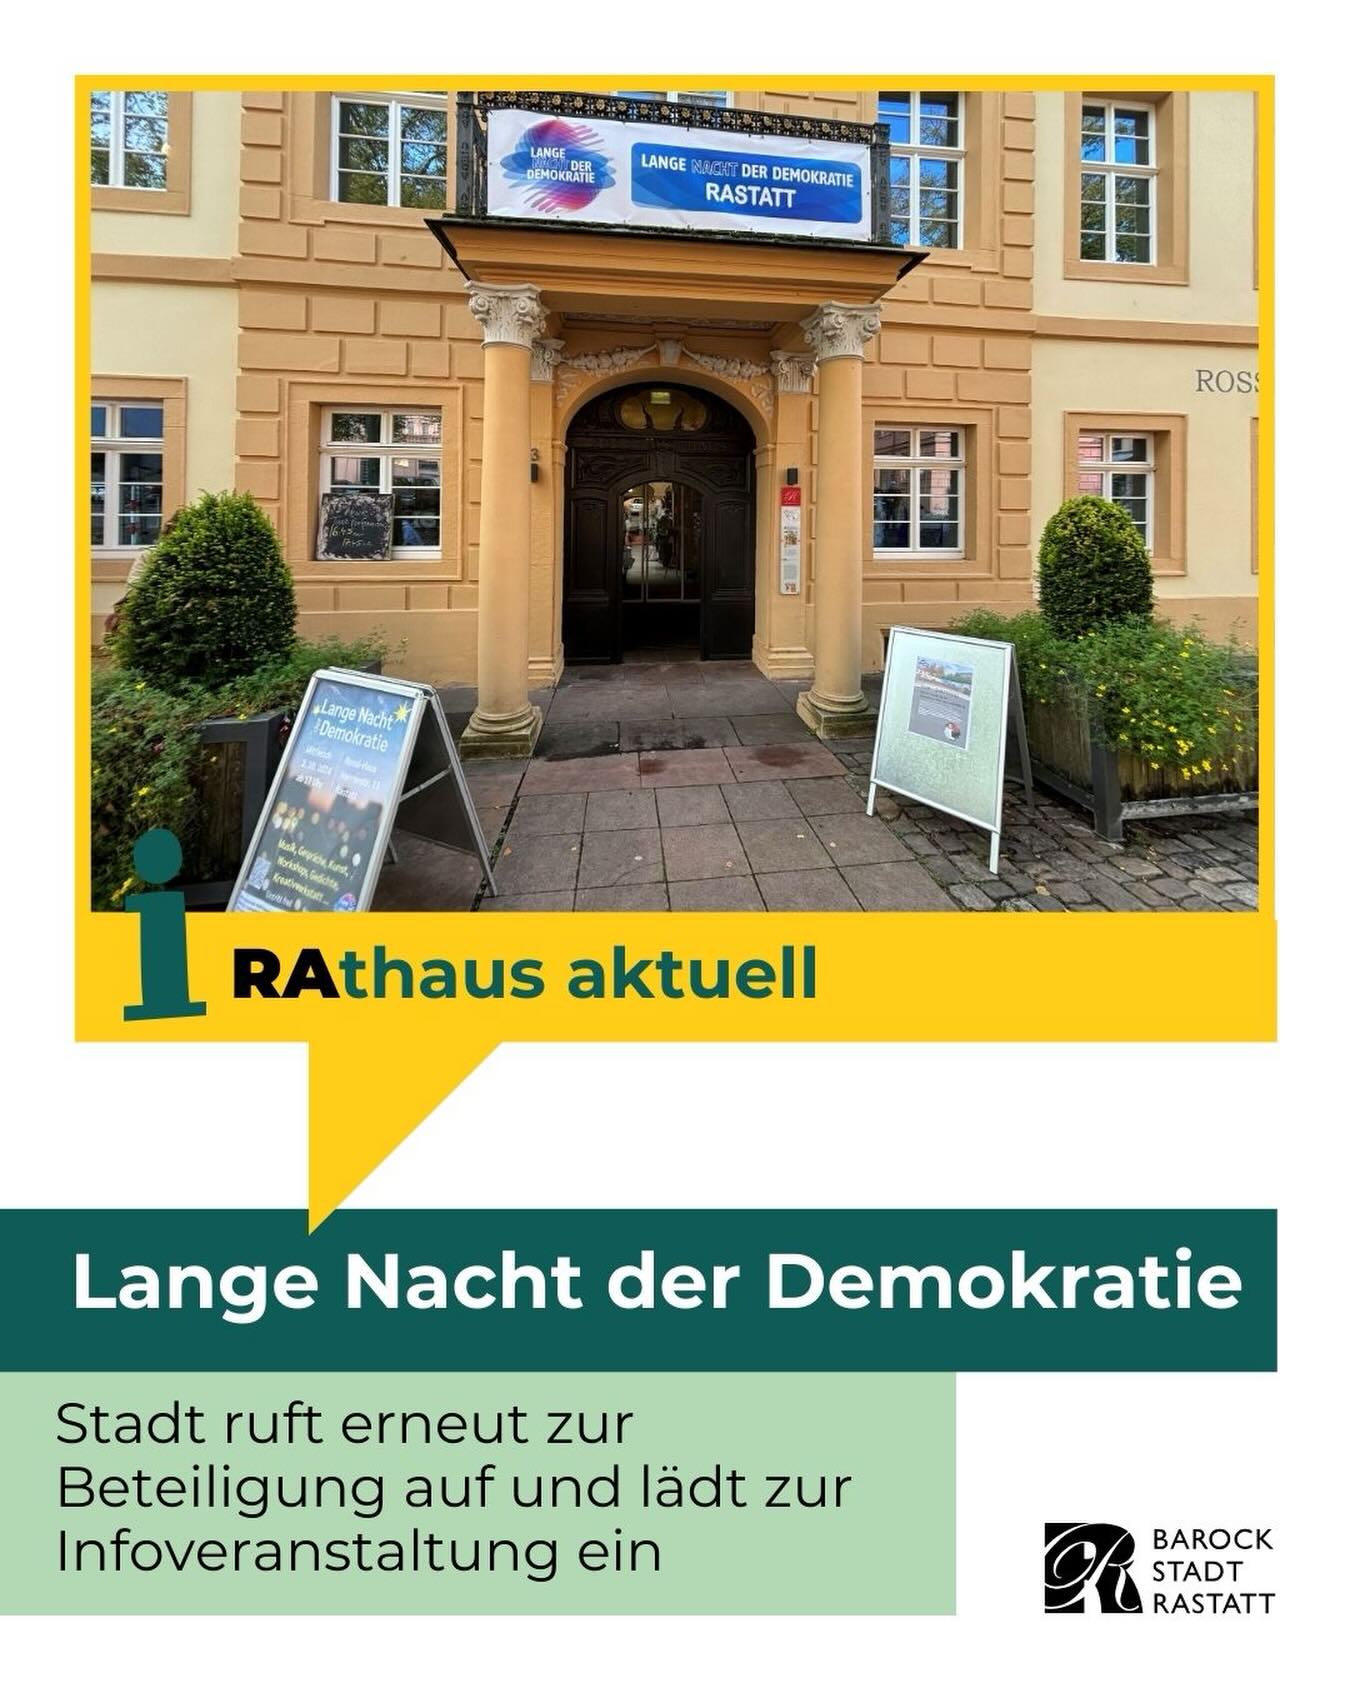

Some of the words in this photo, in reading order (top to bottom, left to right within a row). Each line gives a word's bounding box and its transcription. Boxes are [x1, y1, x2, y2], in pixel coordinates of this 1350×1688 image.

[531, 147, 566, 159] LANGE
[570, 160, 592, 172] DER
[527, 169, 595, 184] DEMOKRATIE
[641, 153, 687, 172] LANGE
[691, 159, 739, 177] NACHT
[741, 163, 767, 179] DER
[772, 166, 854, 188] DEMOKRATIE
[705, 182, 797, 208] RASTATT
[321, 699, 357, 723] Lange
[358, 706, 395, 730] Nacht
[319, 719, 388, 752] Demokratie
